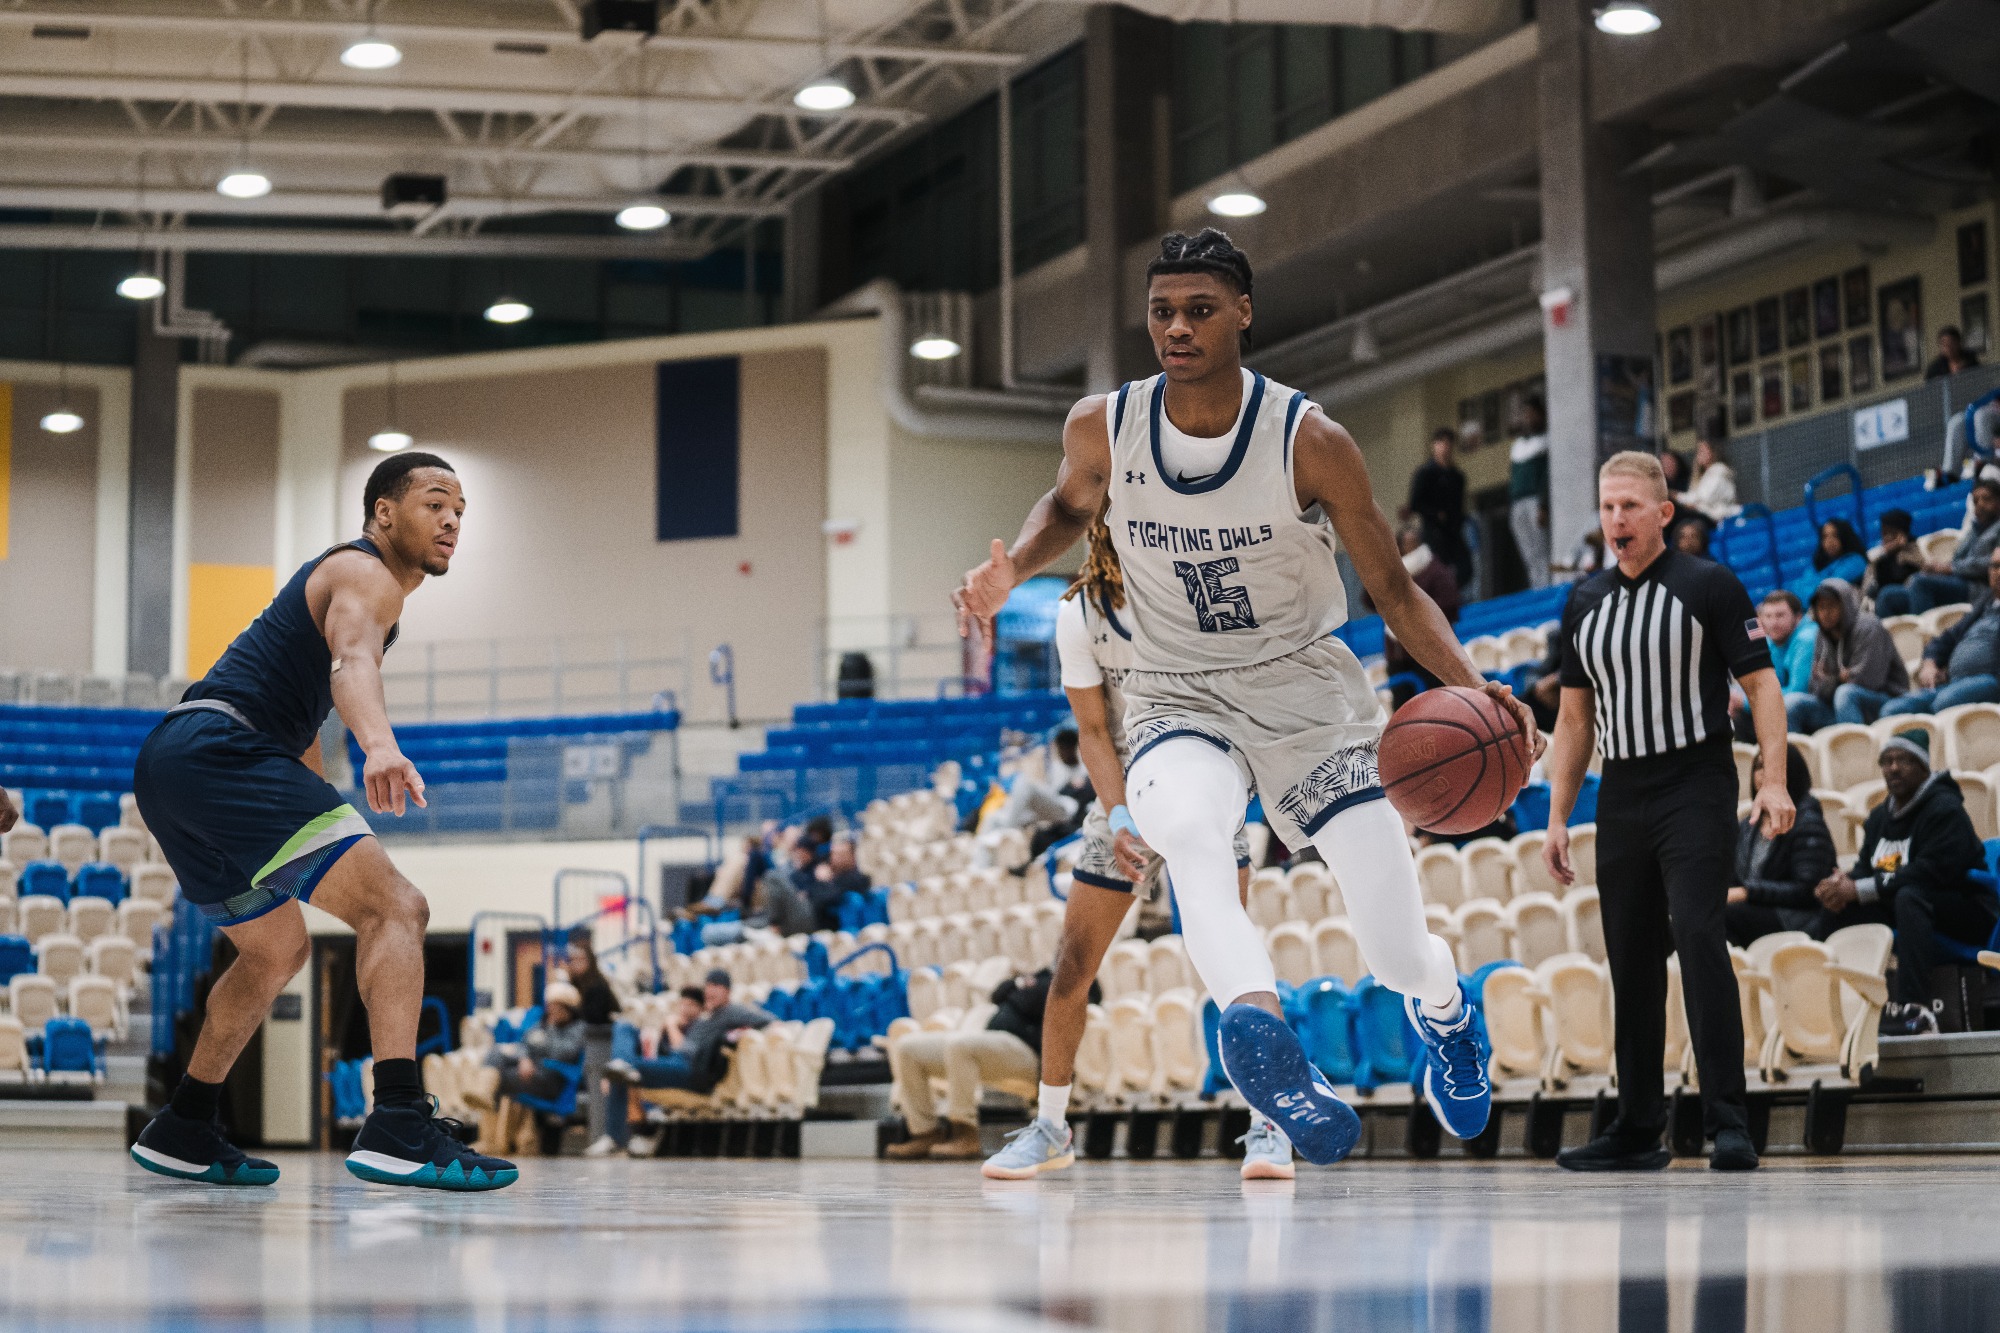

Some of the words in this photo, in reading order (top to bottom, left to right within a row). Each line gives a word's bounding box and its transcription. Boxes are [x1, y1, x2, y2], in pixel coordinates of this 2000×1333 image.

[1127, 520, 1213, 553] FIGHTING
[1217, 524, 1273, 551] OWLS
[1172, 556, 1260, 632] 15
